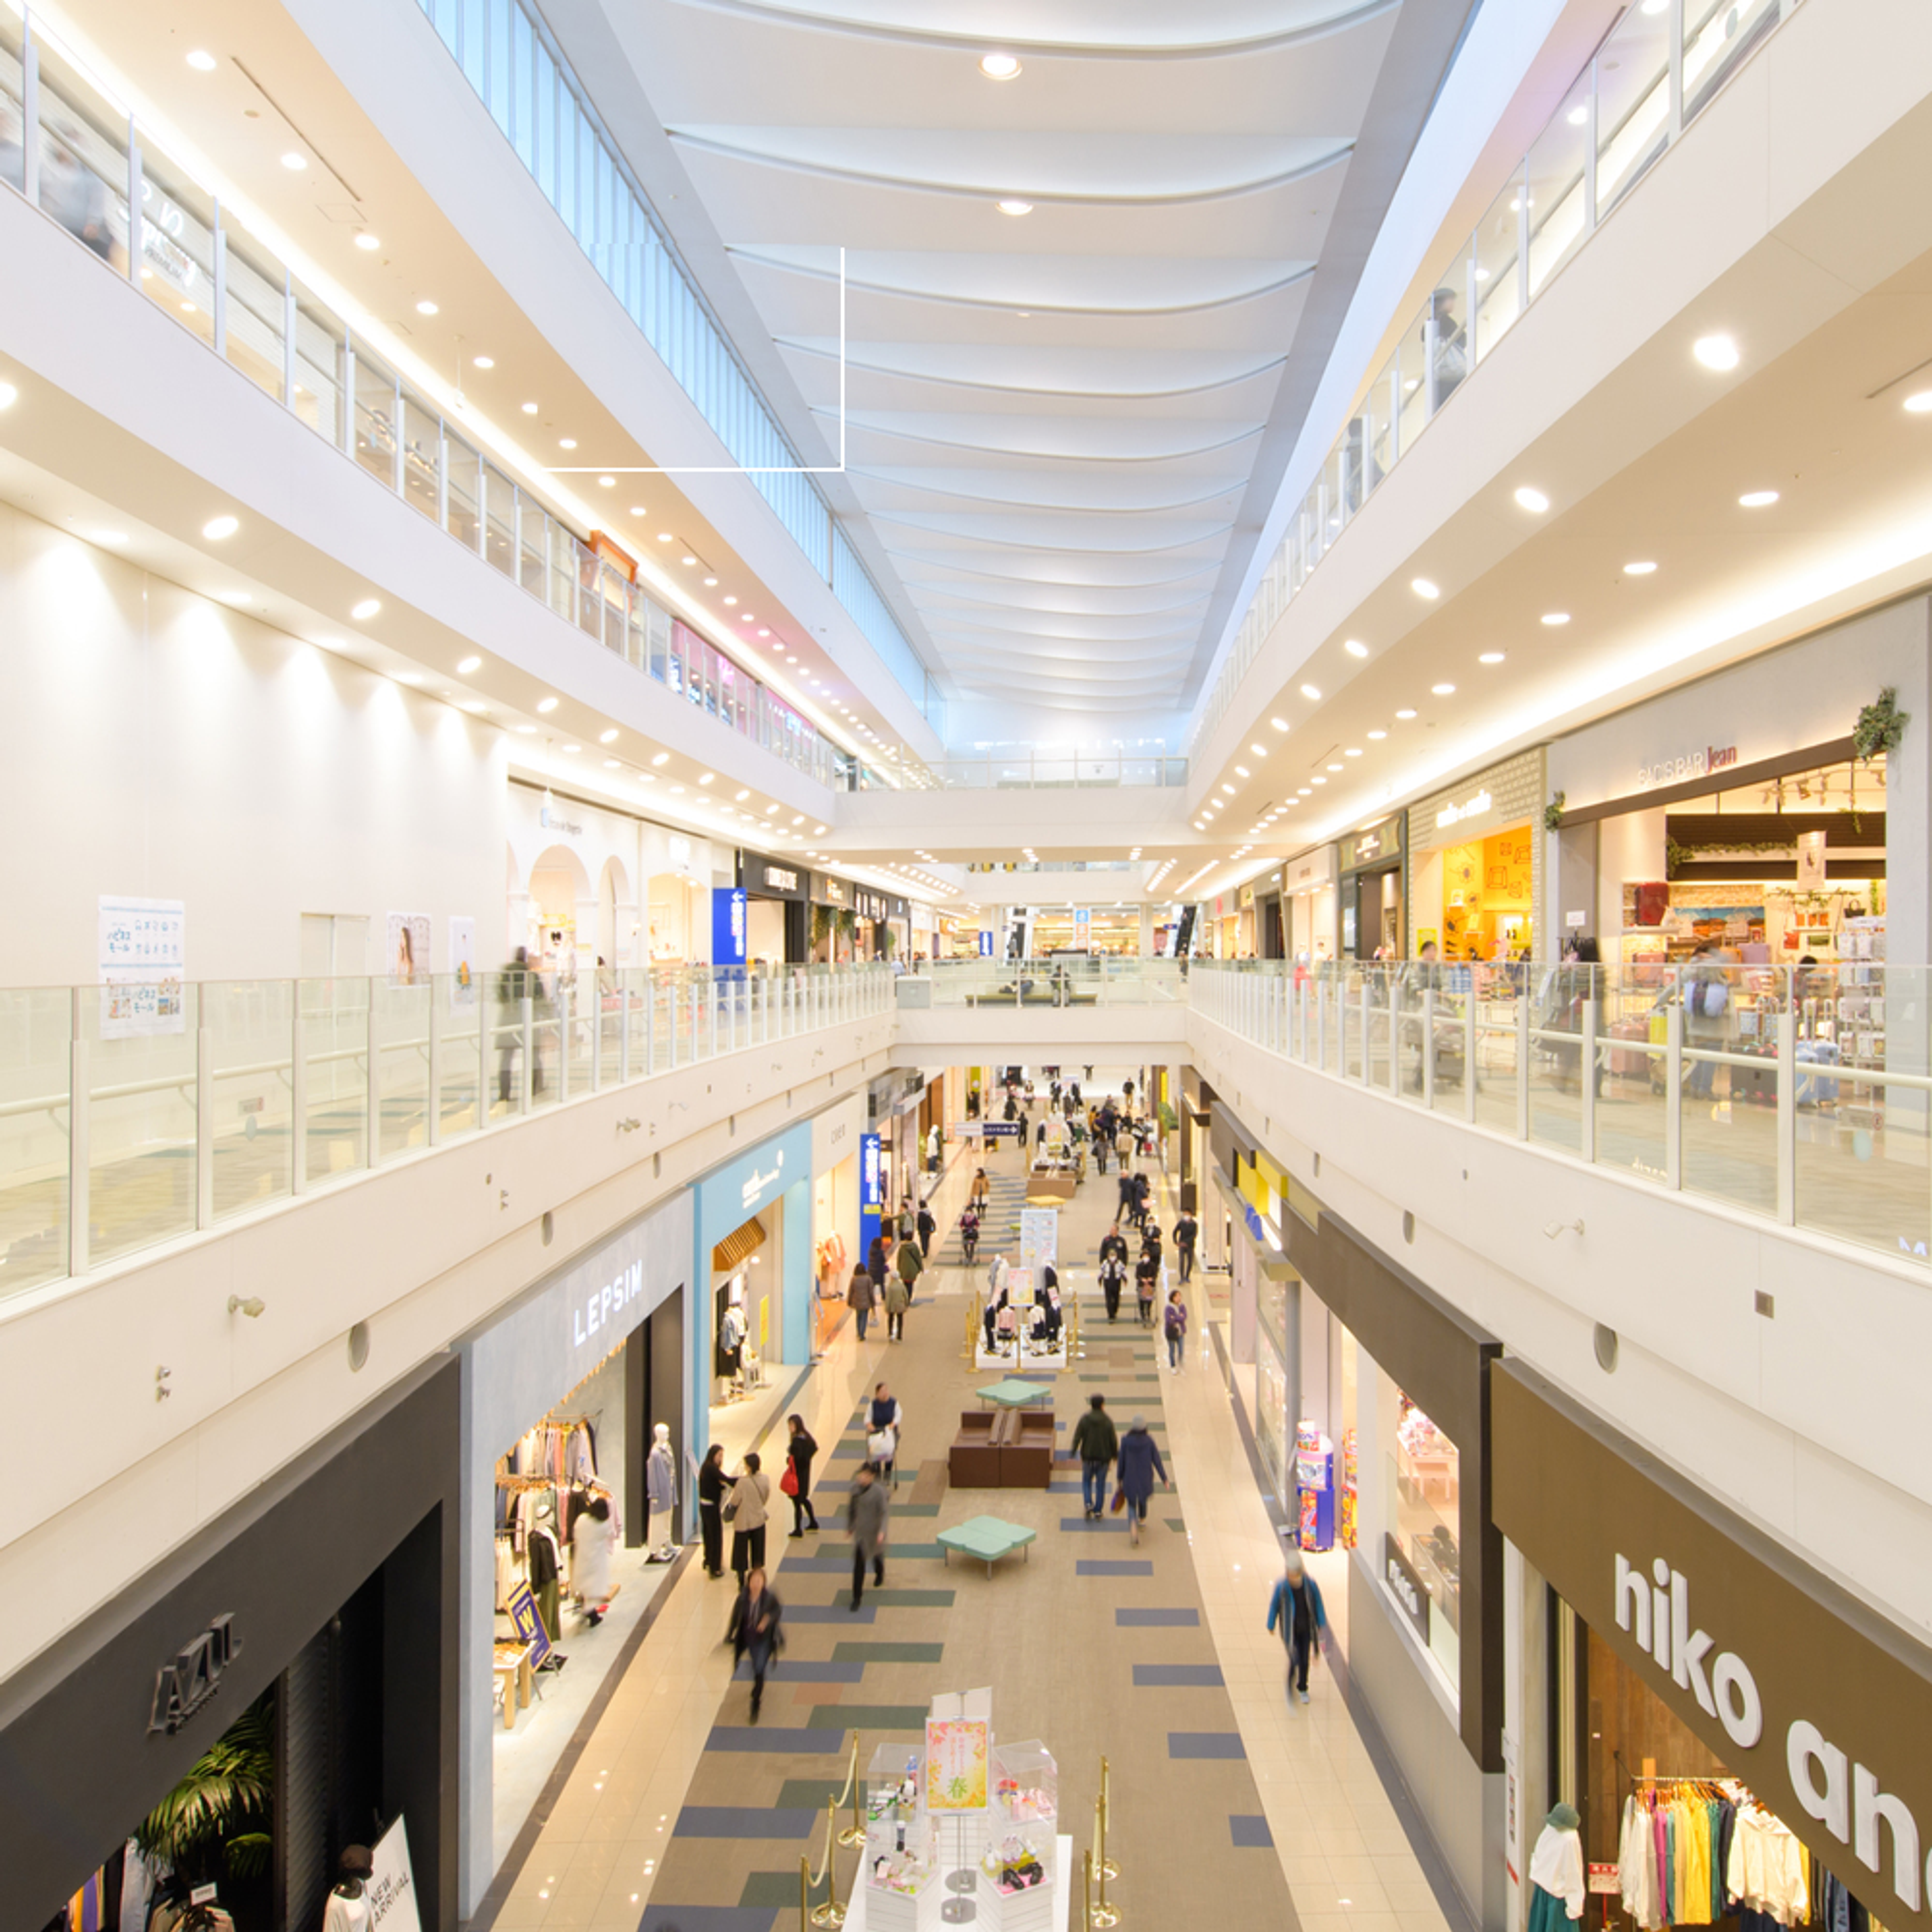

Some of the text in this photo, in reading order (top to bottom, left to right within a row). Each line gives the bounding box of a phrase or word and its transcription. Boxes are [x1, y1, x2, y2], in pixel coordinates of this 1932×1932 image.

[1706, 746, 1737, 775] Jean
[574, 1259, 642, 1347] LEPSIM
[147, 1612, 244, 1734] AZUL
[1615, 1553, 1932, 1915] niko an
[947, 1776, 968, 1799] 春
[371, 1873, 391, 1911] NEW
[374, 1871, 410, 1928] ARRIVAL
